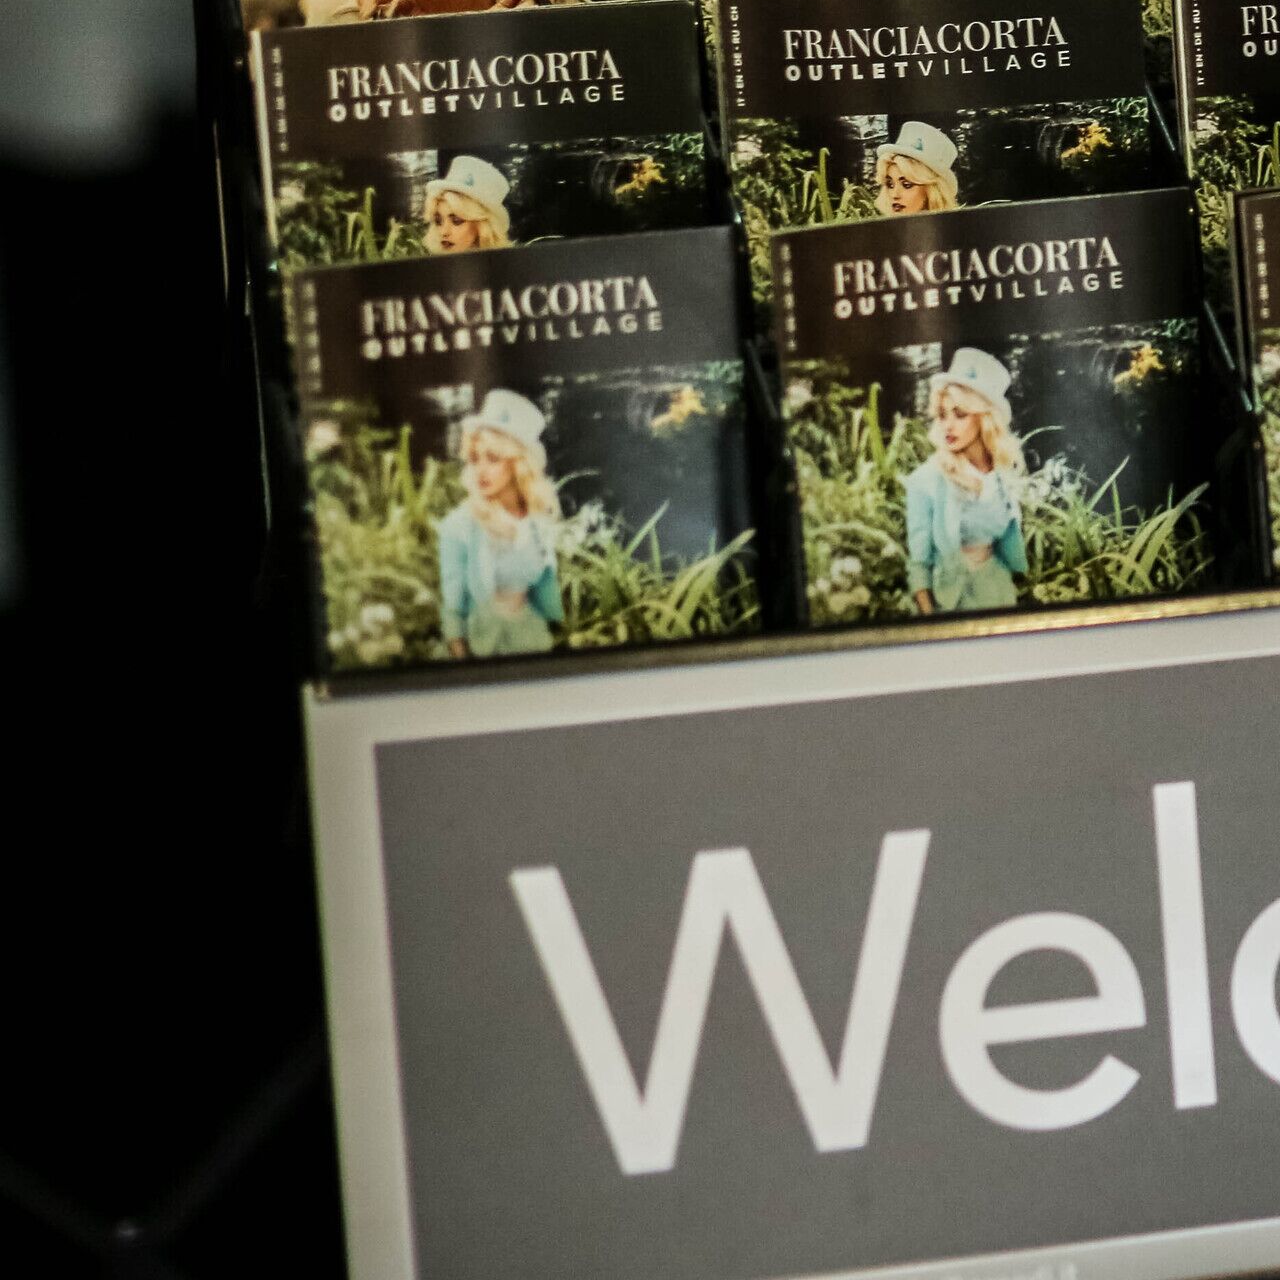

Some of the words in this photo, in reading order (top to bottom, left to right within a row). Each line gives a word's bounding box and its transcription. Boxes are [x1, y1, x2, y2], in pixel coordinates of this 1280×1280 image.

[783, 16, 1068, 61] FRANCIACORTA
[327, 49, 623, 100] FRANCIACORTA
[833, 235, 1120, 297] FRANCIACORTA
[361, 276, 657, 334] FRANCIACORTA
